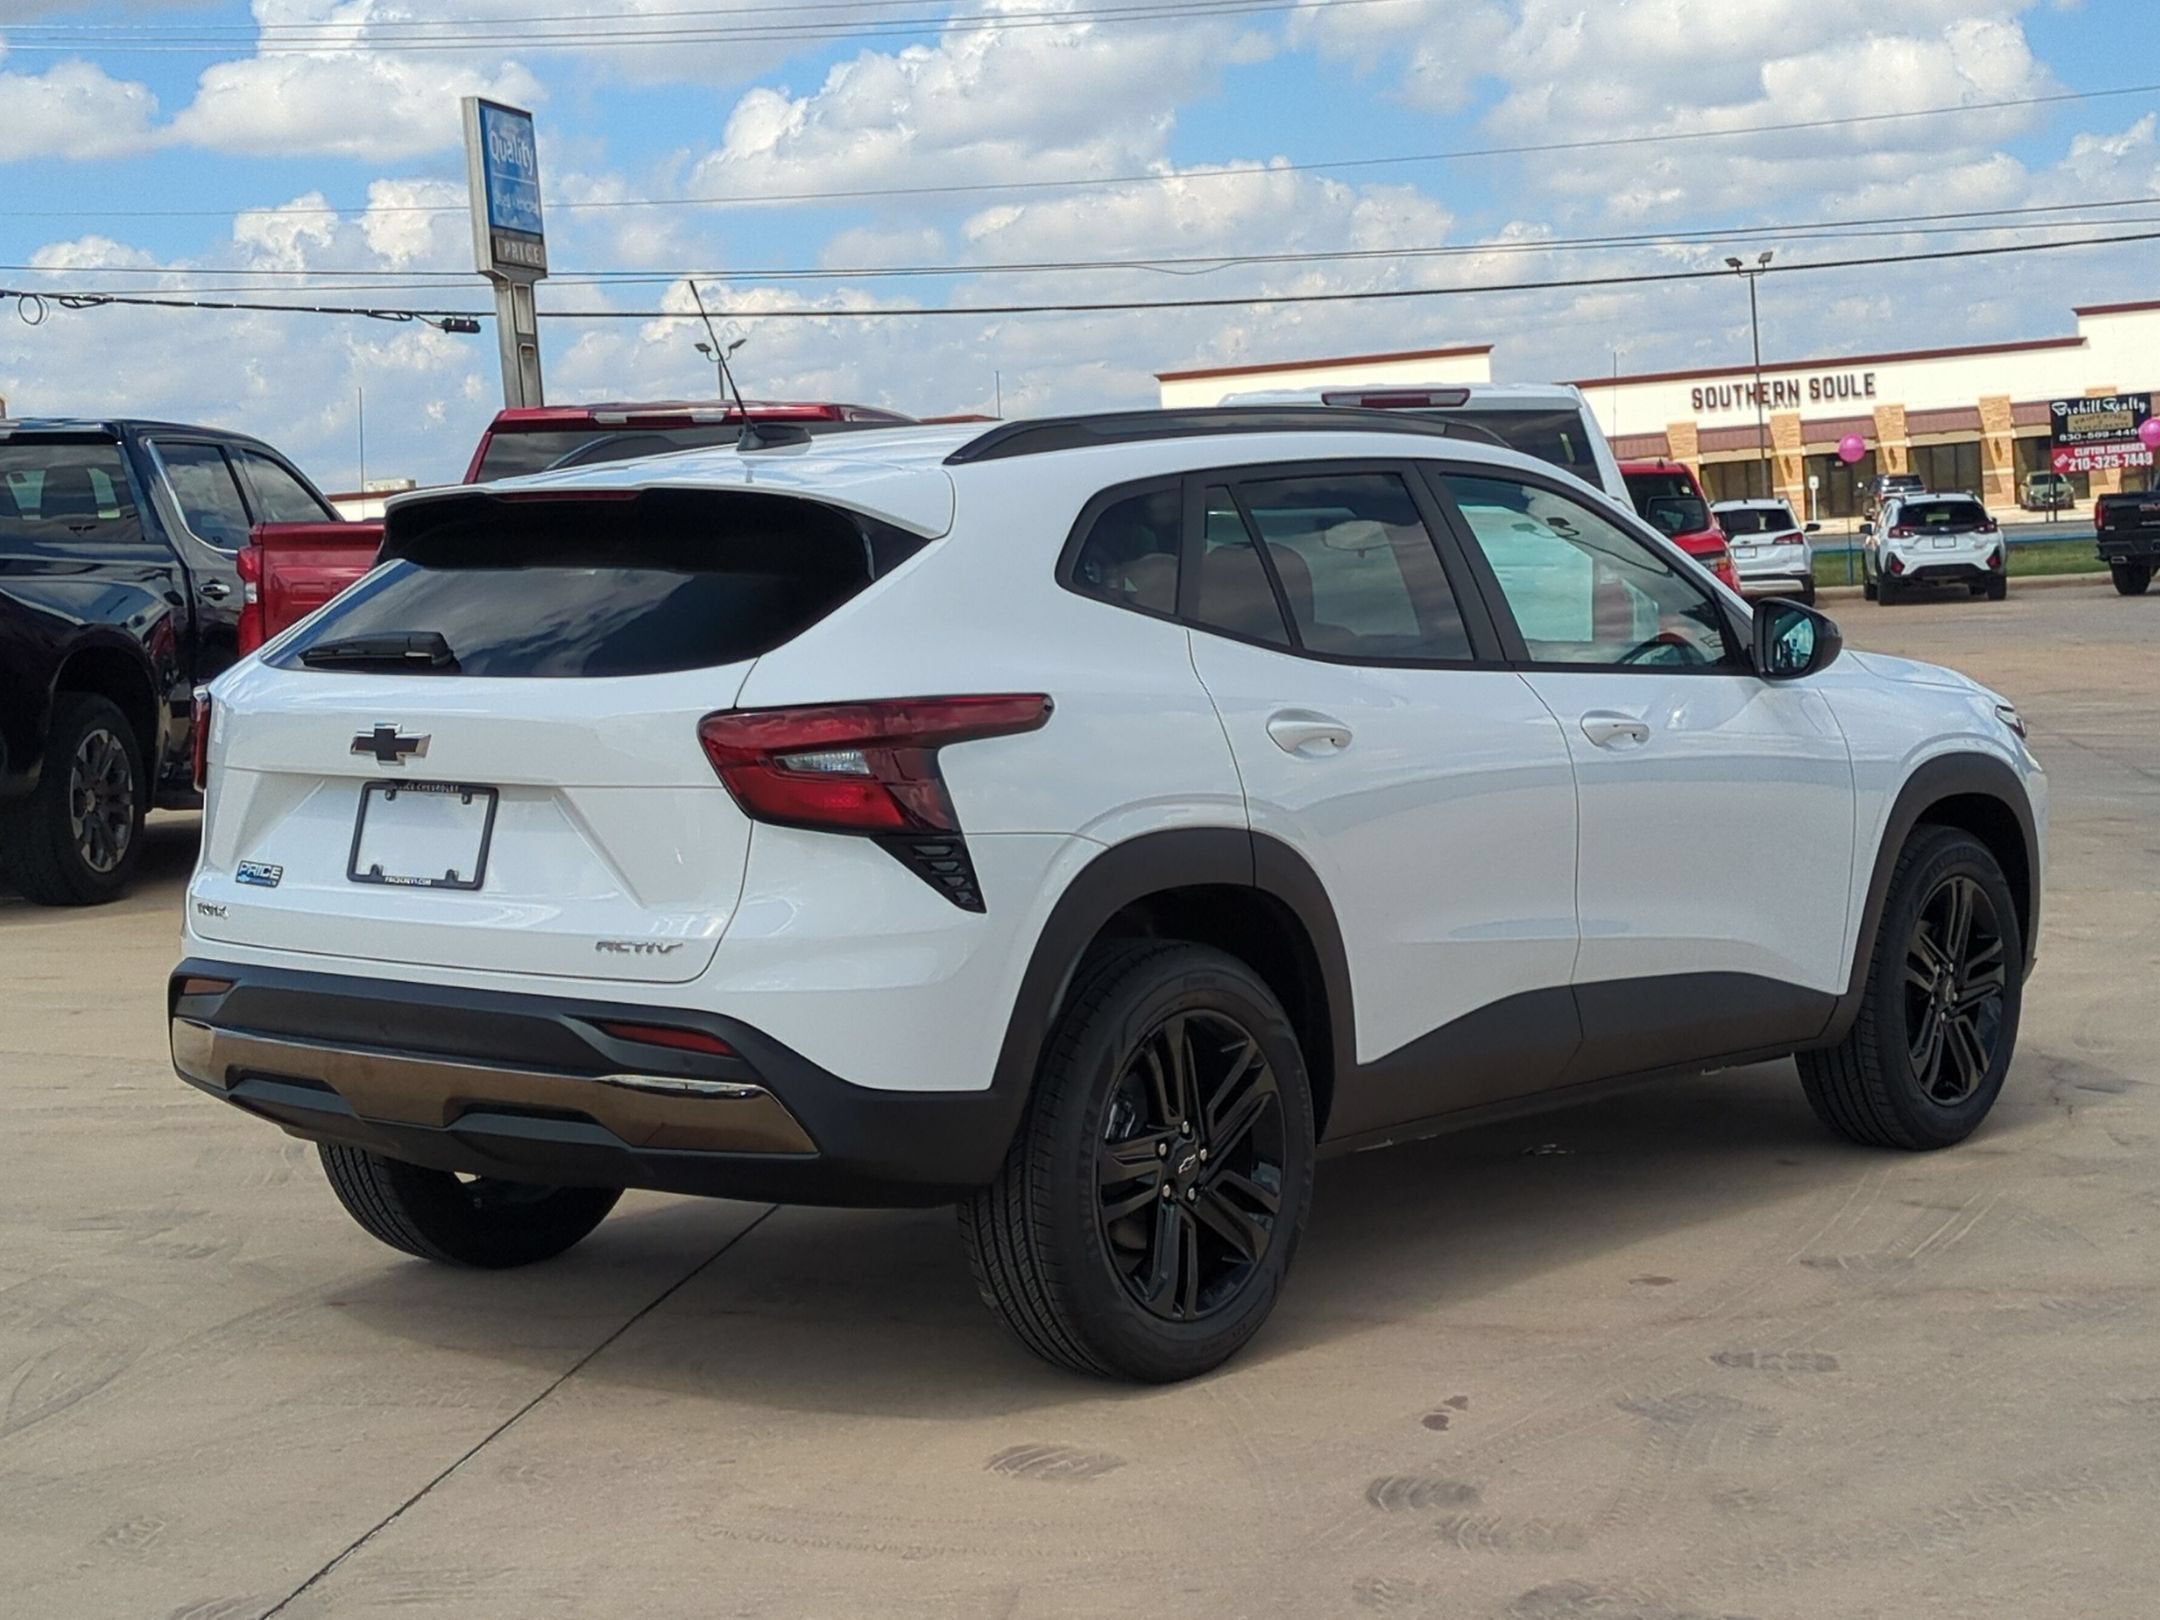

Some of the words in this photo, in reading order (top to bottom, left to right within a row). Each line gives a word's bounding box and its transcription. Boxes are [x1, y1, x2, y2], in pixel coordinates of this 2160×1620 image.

[489, 131, 534, 175] Quality
[504, 240, 541, 264] PRICE
[1691, 379, 1800, 410] SOUTHERN
[1808, 372, 1875, 401] SOULE
[240, 862, 282, 880] PRICE
